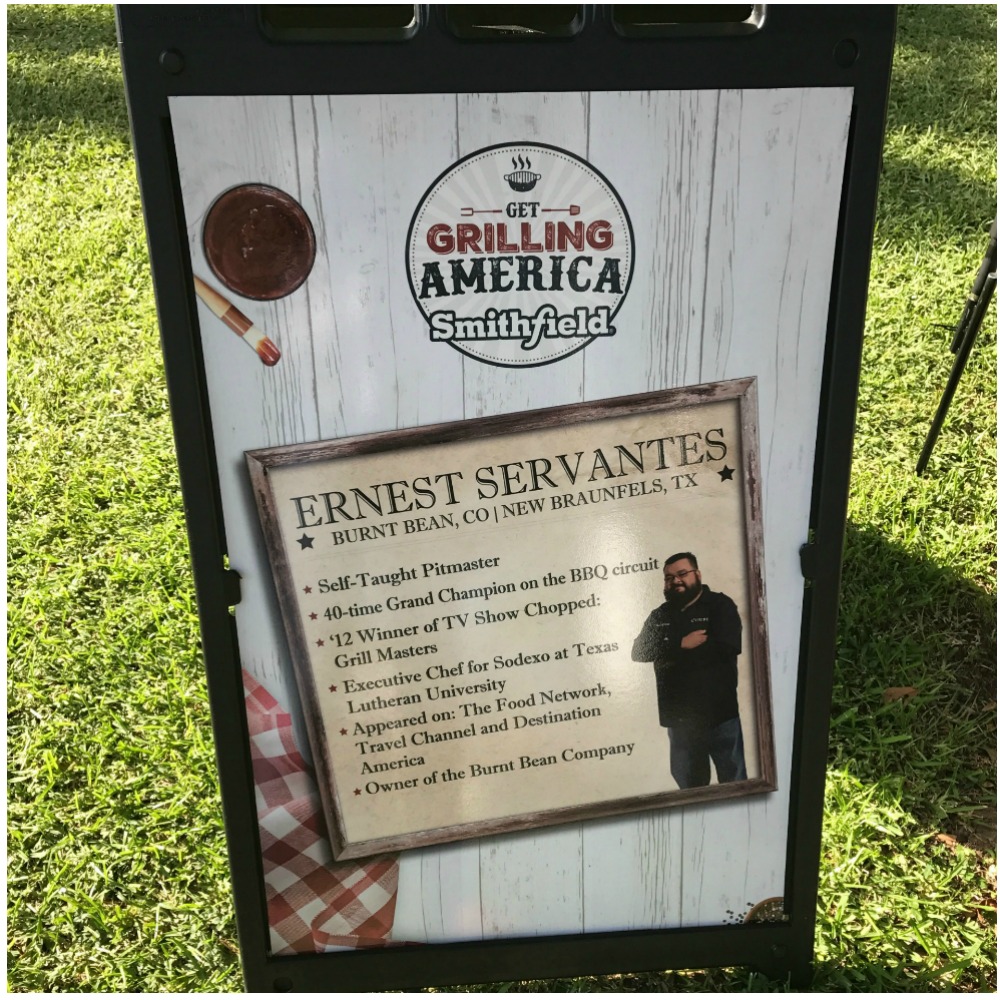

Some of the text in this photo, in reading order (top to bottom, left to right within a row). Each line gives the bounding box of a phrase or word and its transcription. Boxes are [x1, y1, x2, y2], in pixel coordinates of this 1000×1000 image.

[506, 202, 540, 218] GET
[427, 220, 614, 254] GRILLING
[419, 256, 623, 299] AMERICA
[430, 304, 616, 350] Smithfield
[290, 428, 728, 529] ERNEST SERVANTES
[332, 472, 698, 546] BURNT BEAN, CO NEW BRAUNFELS, TX
[318, 556, 500, 594] Self-Taught Pitmaster
[323, 558, 660, 621] 40-time Grand Champion on the BBQ circuit
[356, 623, 419, 644] Winner
[423, 617, 439, 633] of
[442, 613, 469, 630] TV
[474, 608, 519, 625] Show
[524, 594, 601, 617] Chopped:
[334, 642, 438, 669] Grill Masters
[344, 641, 619, 695] Executive Chef for Sodexo at Texas
[347, 678, 506, 715] Lutheran University
[352, 683, 612, 738] Appeared on: The Food Network,
[355, 705, 602, 755] Travel Channel and Destination
[360, 755, 425, 775] America
[365, 742, 636, 796] Owner of the Burnt Bean Company
